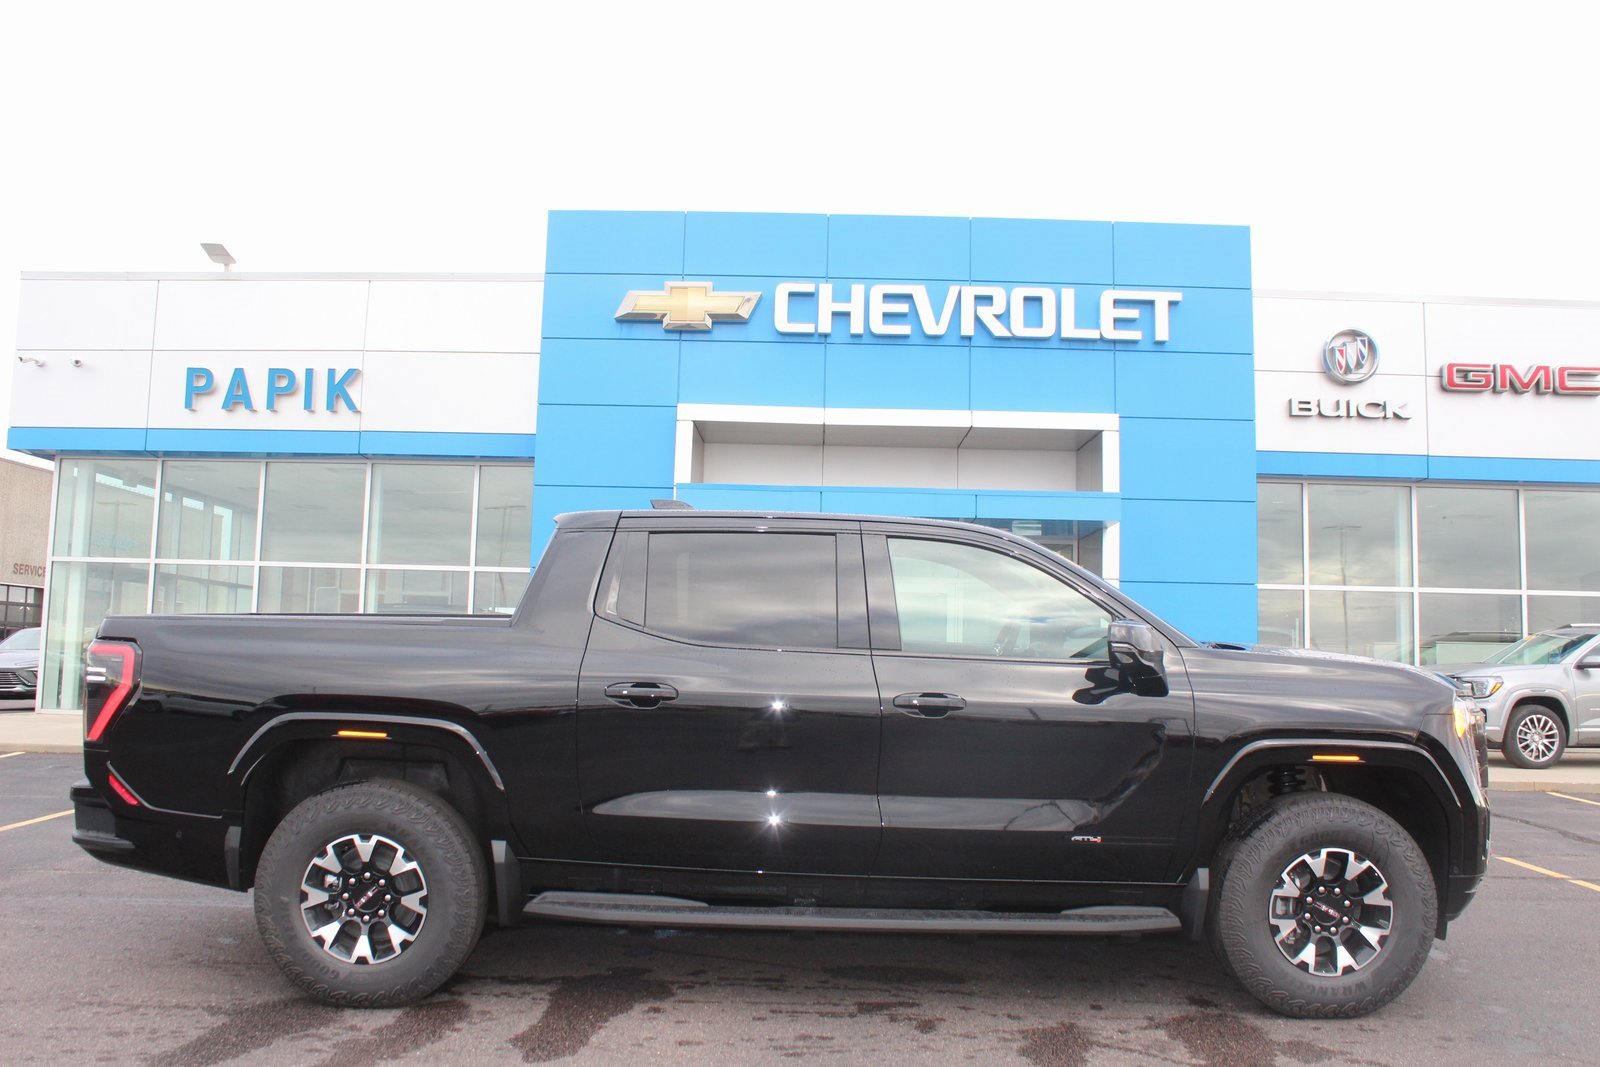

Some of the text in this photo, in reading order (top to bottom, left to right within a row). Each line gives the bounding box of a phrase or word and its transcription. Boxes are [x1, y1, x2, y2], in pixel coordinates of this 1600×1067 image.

[774, 282, 1183, 342] CHEVROLET
[184, 367, 361, 412] PAPIK
[1440, 362, 1600, 396] GMC
[1289, 398, 1412, 420] BUICK
